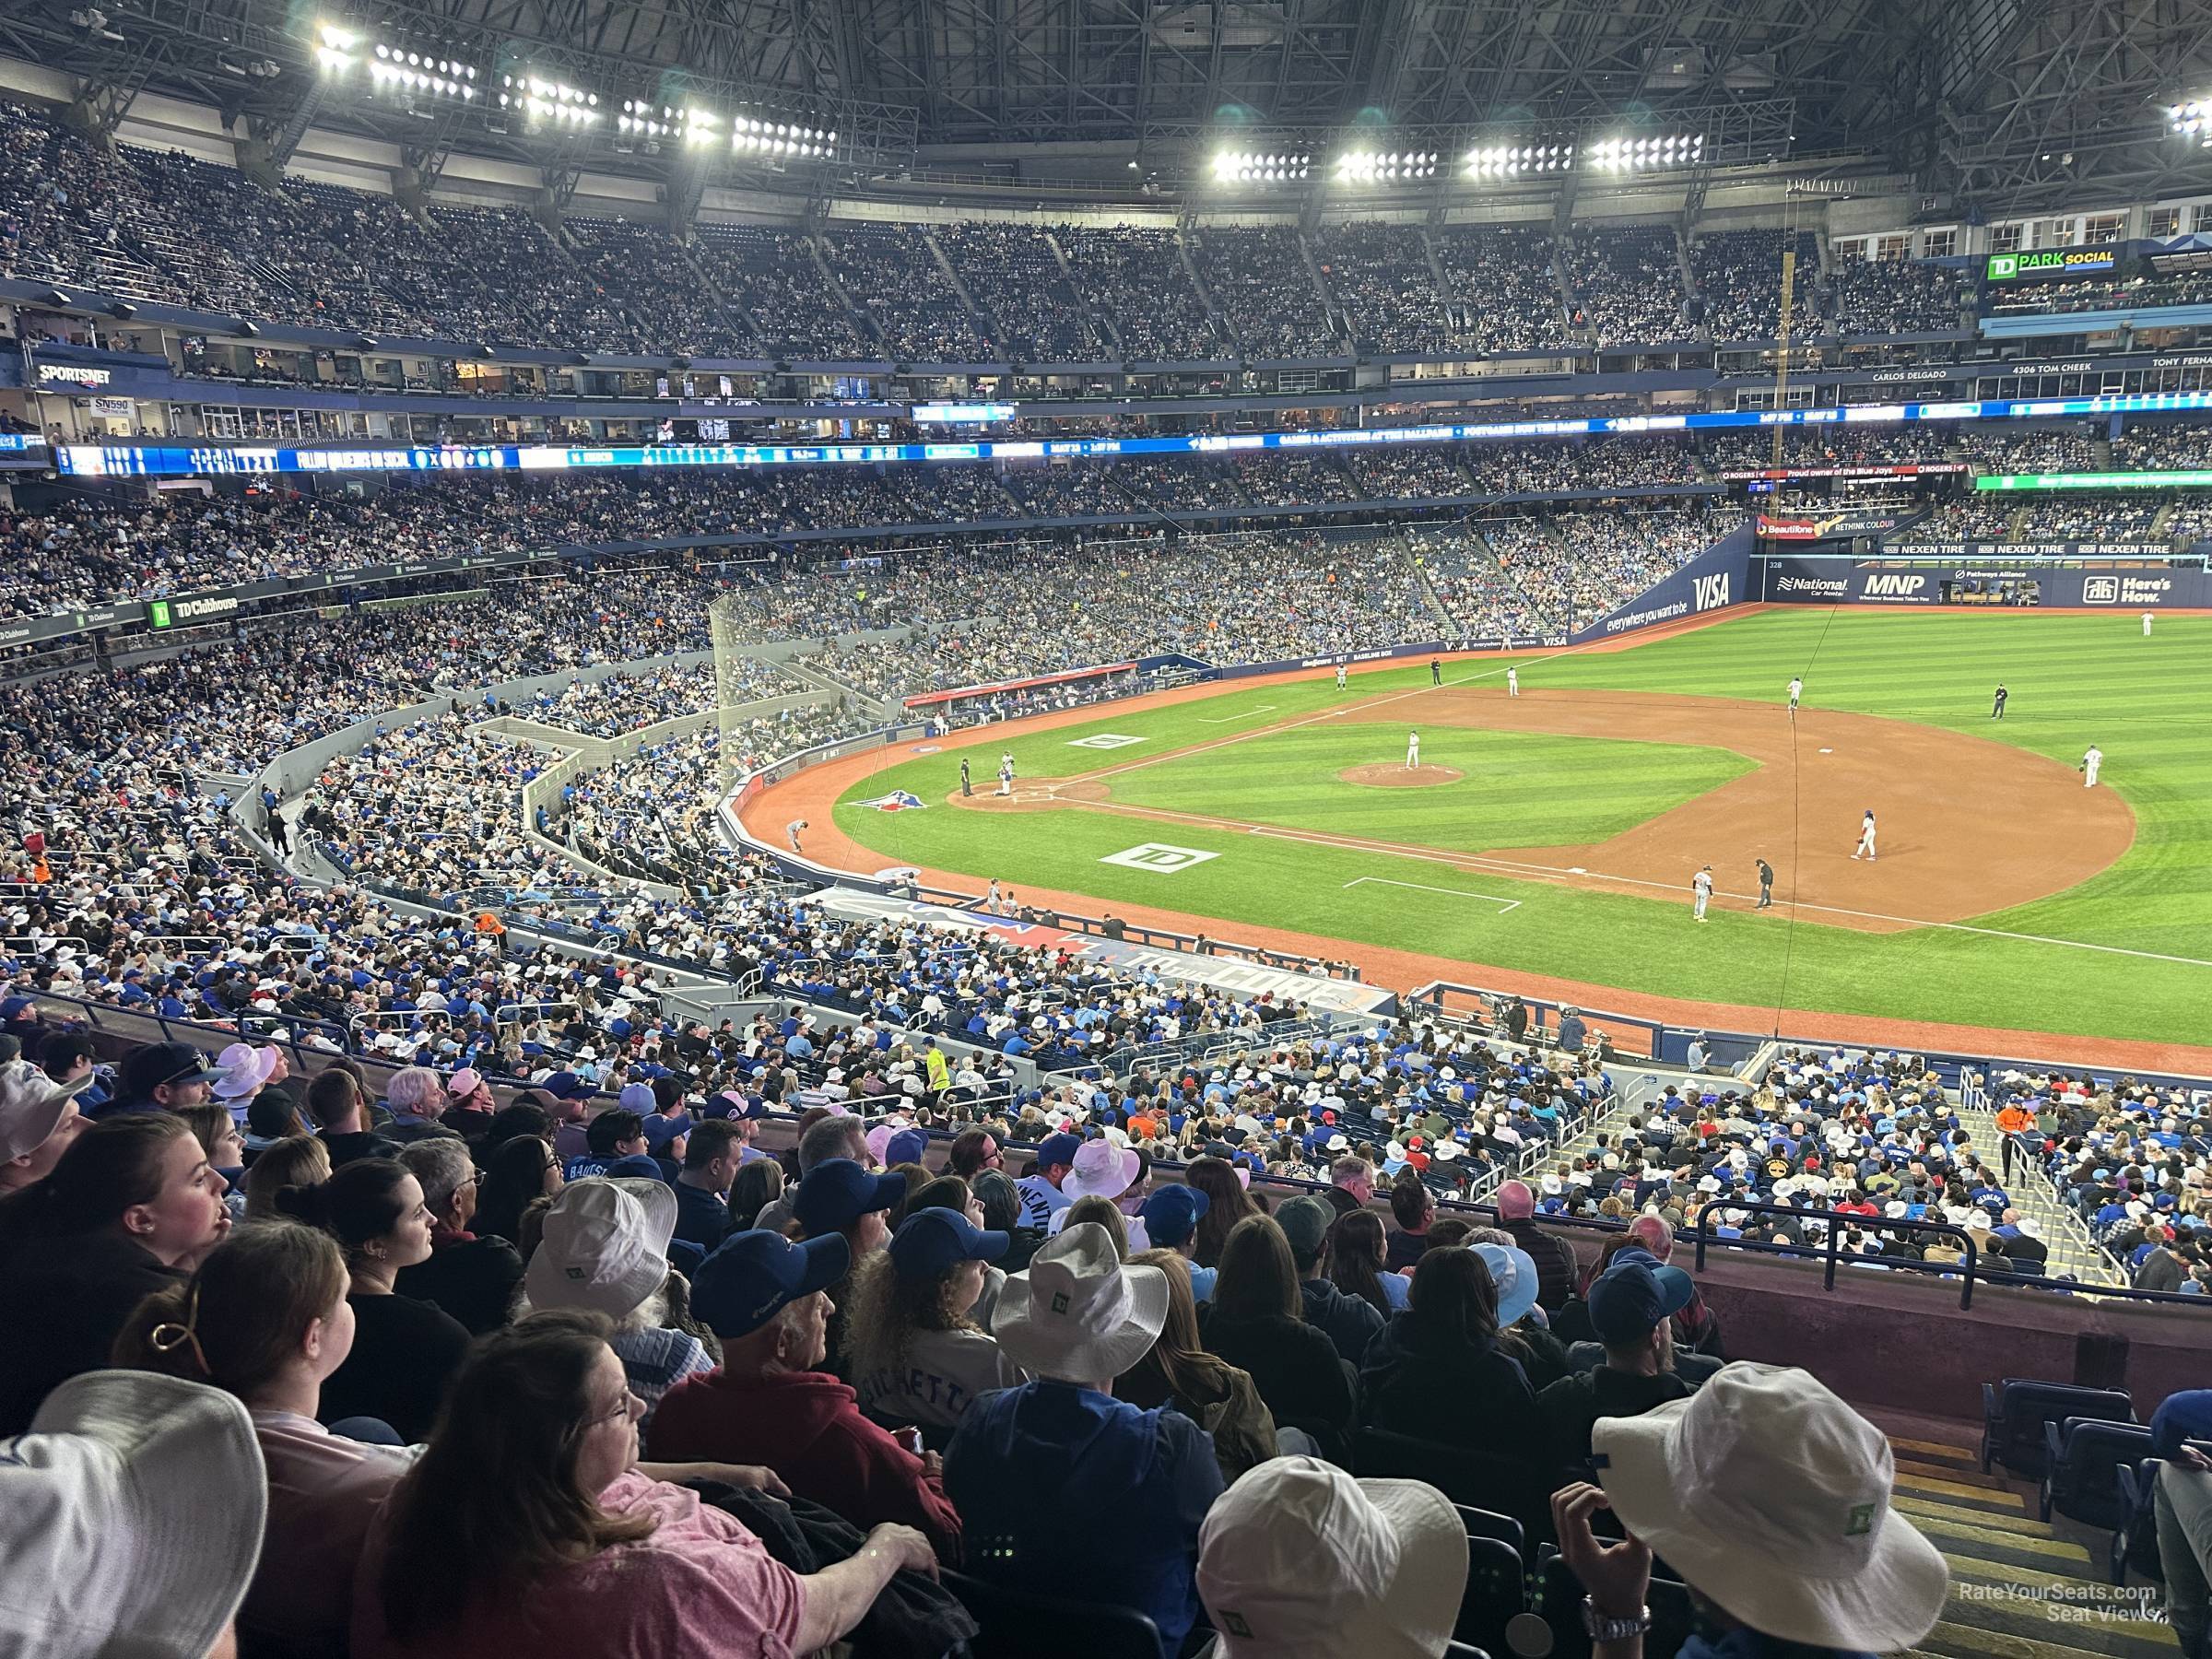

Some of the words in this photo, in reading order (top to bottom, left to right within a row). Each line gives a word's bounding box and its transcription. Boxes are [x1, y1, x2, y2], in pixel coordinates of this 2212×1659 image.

[1991, 258, 2016, 275] TD
[2018, 252, 2065, 267] PARK
[2065, 251, 2114, 265] SOCIAL
[2013, 365, 2036, 374] 4306
[2038, 364, 2058, 373] TOM
[2061, 362, 2091, 372] CHEEK
[2153, 358, 2179, 367] TONY
[39, 364, 111, 383] SPORTSNET
[1873, 372, 1904, 382] CARLOS
[1907, 371, 1947, 380] DELGADO
[95, 398, 128, 409] SN590
[1320, 432, 1371, 444] ACTIVITIES
[1404, 428, 1453, 439] BALLPARK
[1875, 466, 1892, 476] Jays
[1924, 465, 1953, 473] ROGERS
[1835, 523, 1865, 532] RETHINK
[1865, 520, 1895, 530] COLOUR
[1901, 546, 1938, 554] NEXEN
[1940, 545, 1965, 554] TIRE
[1997, 545, 2036, 554] NEXEN
[2040, 545, 2065, 554] TIRE
[2099, 545, 2139, 554] NEXEN
[2142, 545, 2170, 554] TIRE
[1966, 571, 1998, 579] Pathways
[1865, 574, 1924, 594] MNP
[2123, 578, 2171, 591] Here's
[1691, 571, 1729, 612] VISA
[2121, 590, 2160, 603] How.
[174, 603, 192, 618] TD
[193, 597, 238, 616] Clubhouse
[1606, 612, 1645, 631] everywhere
[1644, 609, 1657, 625] you
[1657, 606, 1673, 618] want
[1673, 605, 1678, 615] to
[1678, 601, 1688, 614] be
[1541, 637, 1567, 647] VISA
[1336, 654, 1347, 663] BET
[1353, 650, 1380, 661] BASELINE
[1380, 648, 1393, 658] BOX
[1128, 847, 1197, 865] TD
